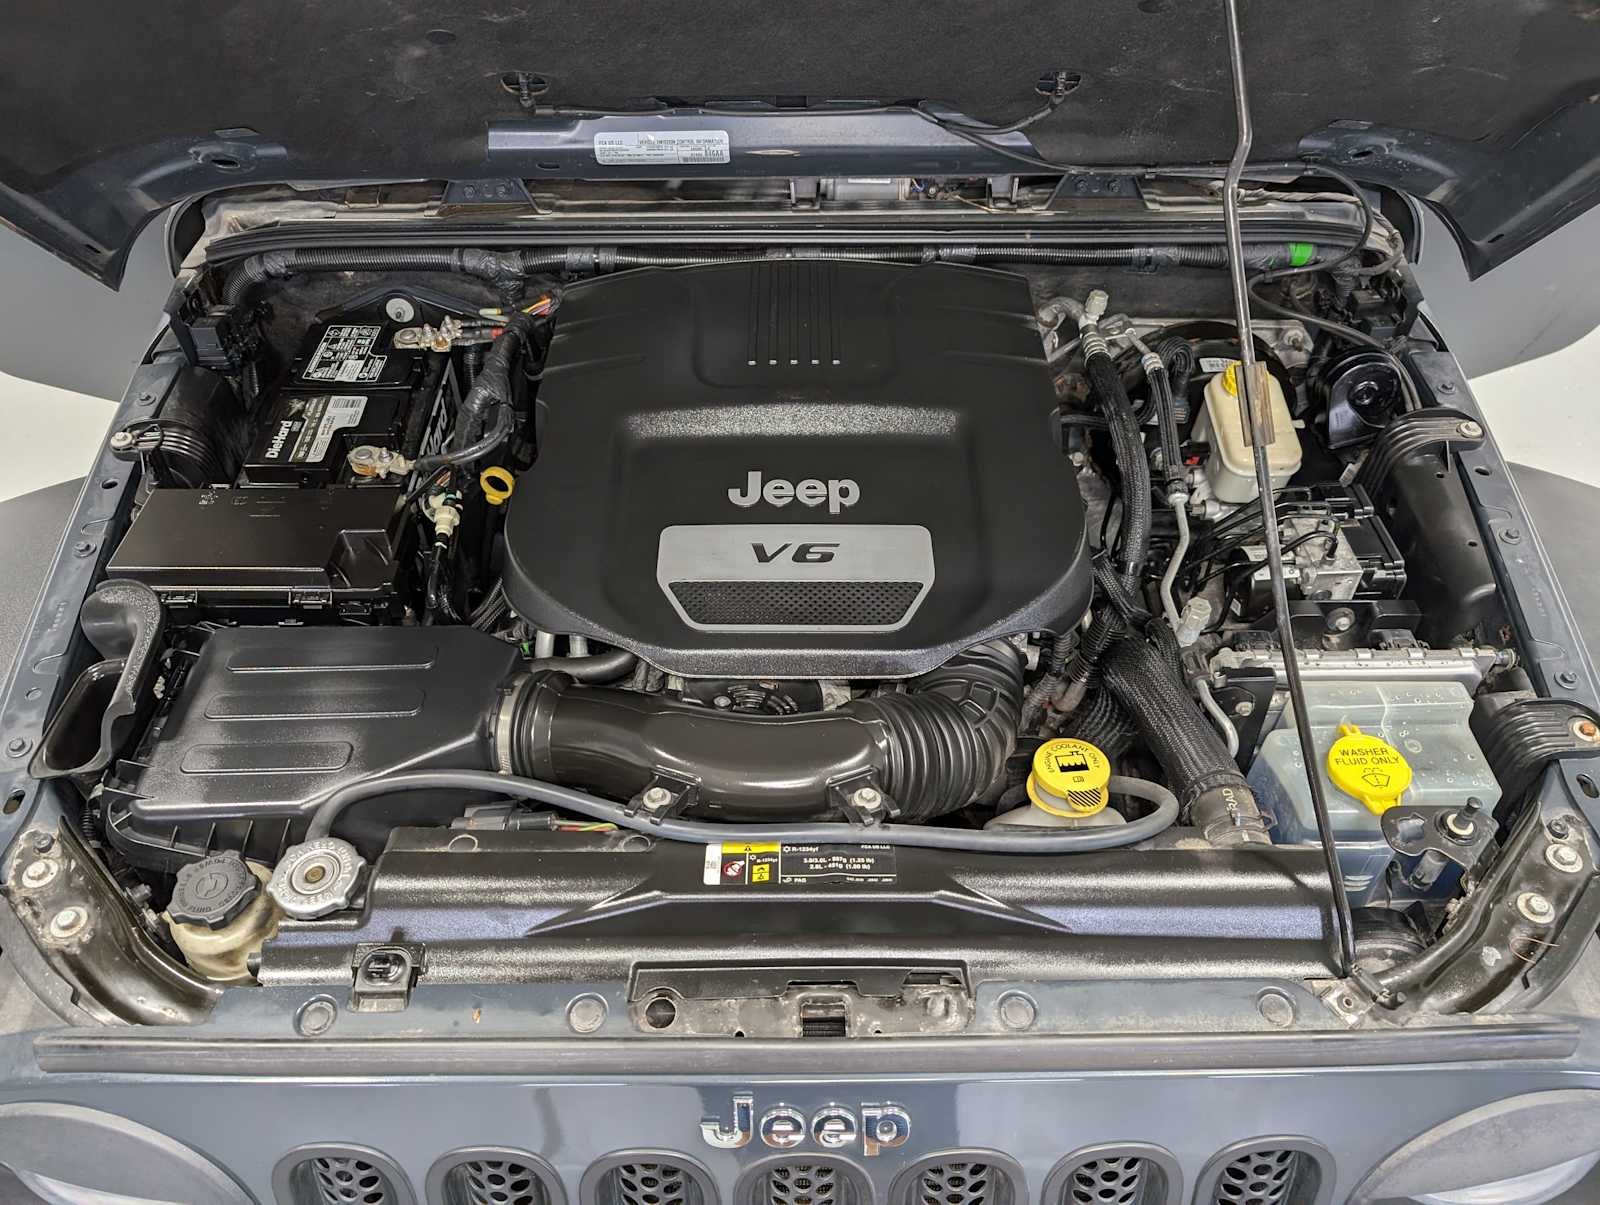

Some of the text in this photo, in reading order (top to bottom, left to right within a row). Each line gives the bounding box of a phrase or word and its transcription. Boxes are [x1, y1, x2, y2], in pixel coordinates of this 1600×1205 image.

[265, 420, 293, 458] DieHard
[728, 471, 860, 513] Jeep
[751, 543, 840, 563] V6
[1051, 743, 1089, 753] COOLANT
[1339, 747, 1389, 757] WASHER
[1335, 755, 1399, 766] FLUID ONLY
[701, 1091, 911, 1156] Jeep
